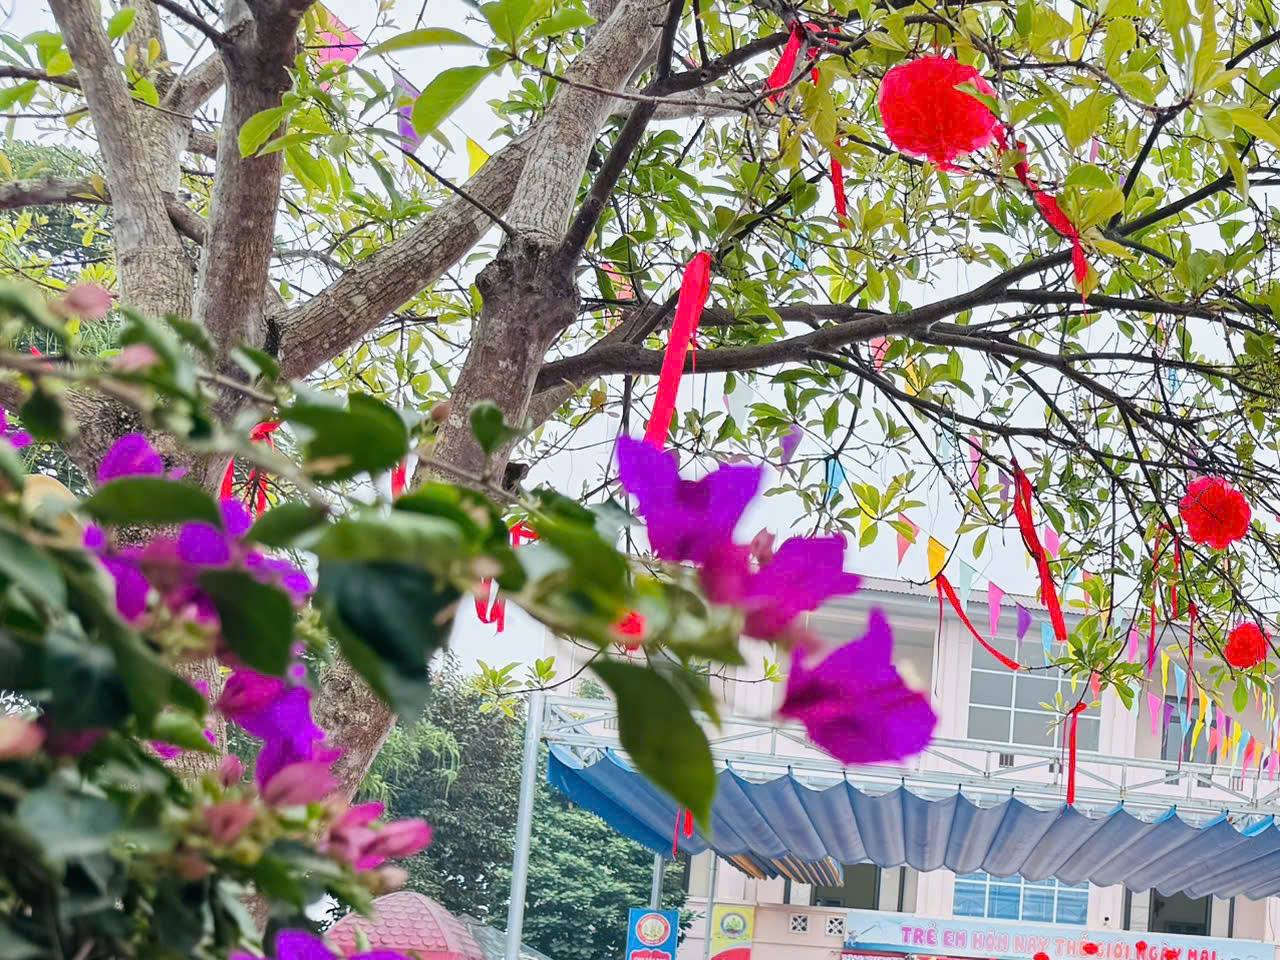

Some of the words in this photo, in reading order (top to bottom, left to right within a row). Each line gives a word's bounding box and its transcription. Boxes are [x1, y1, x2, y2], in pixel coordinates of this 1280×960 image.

[901, 920, 937, 946] TRẺ
[943, 930, 967, 949] EM
[972, 929, 1009, 953] HÔM
[1013, 934, 1050, 954] NAY
